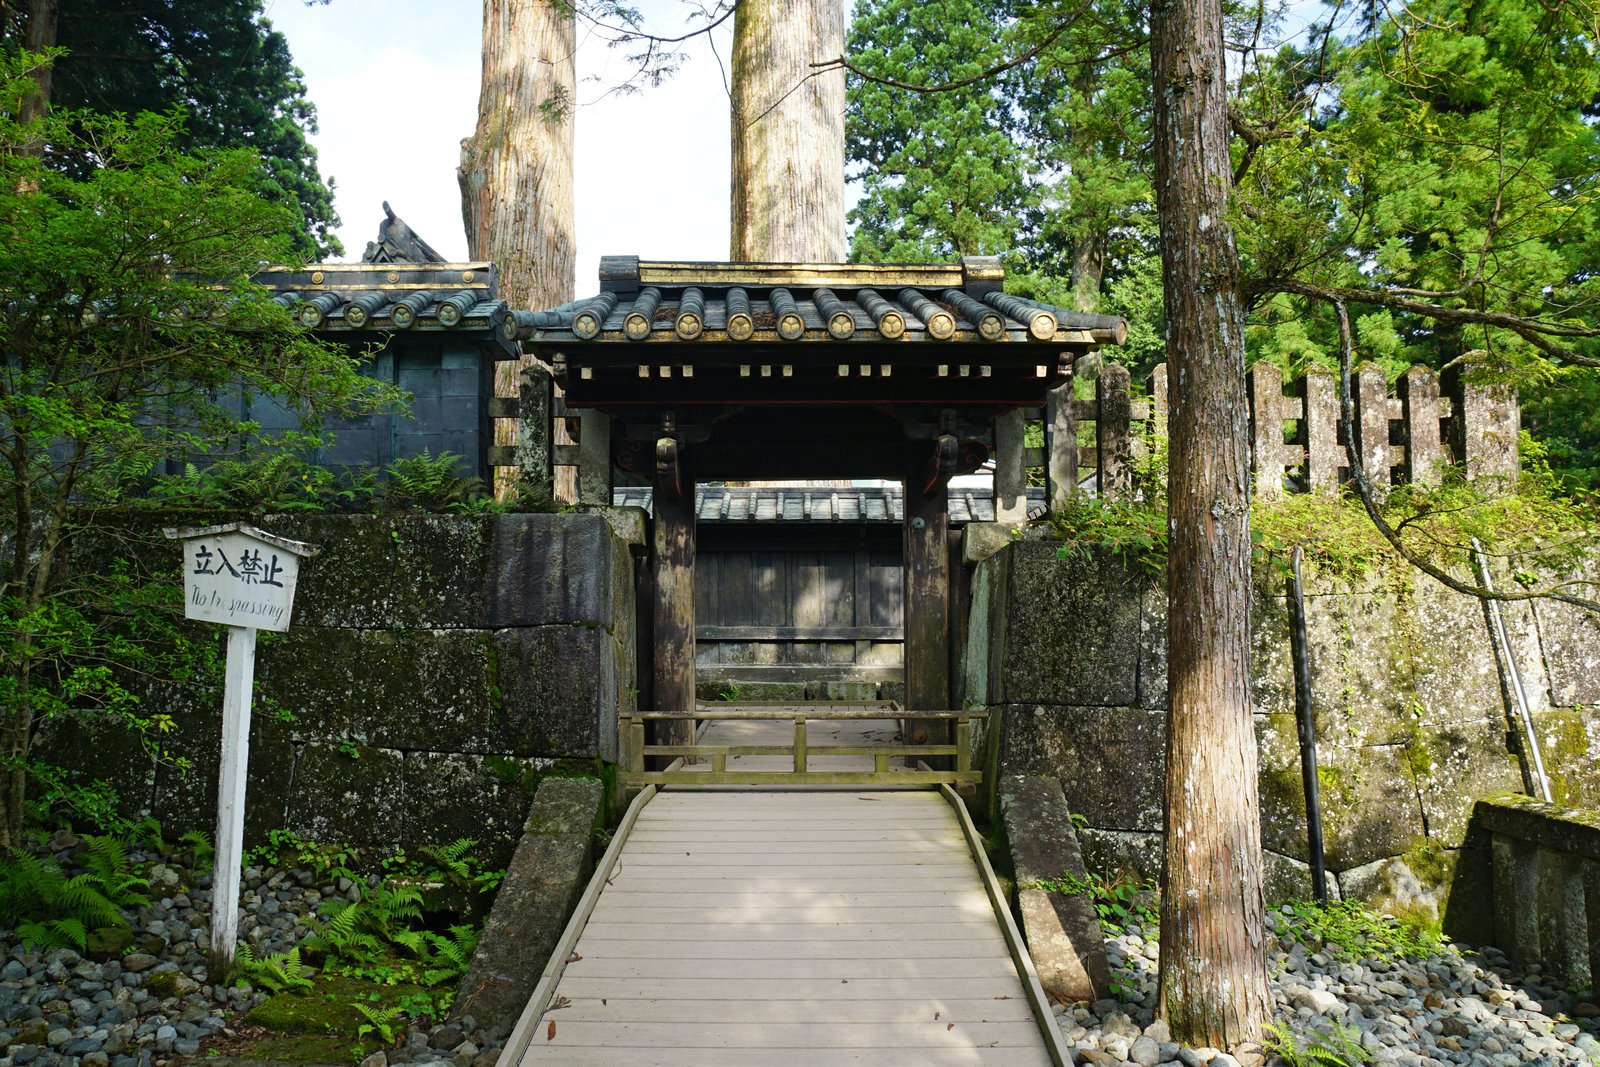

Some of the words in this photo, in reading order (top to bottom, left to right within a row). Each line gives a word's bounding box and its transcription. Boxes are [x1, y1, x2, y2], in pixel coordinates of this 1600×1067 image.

[193, 544, 284, 588] 立入禁止
[191, 584, 207, 606] No
